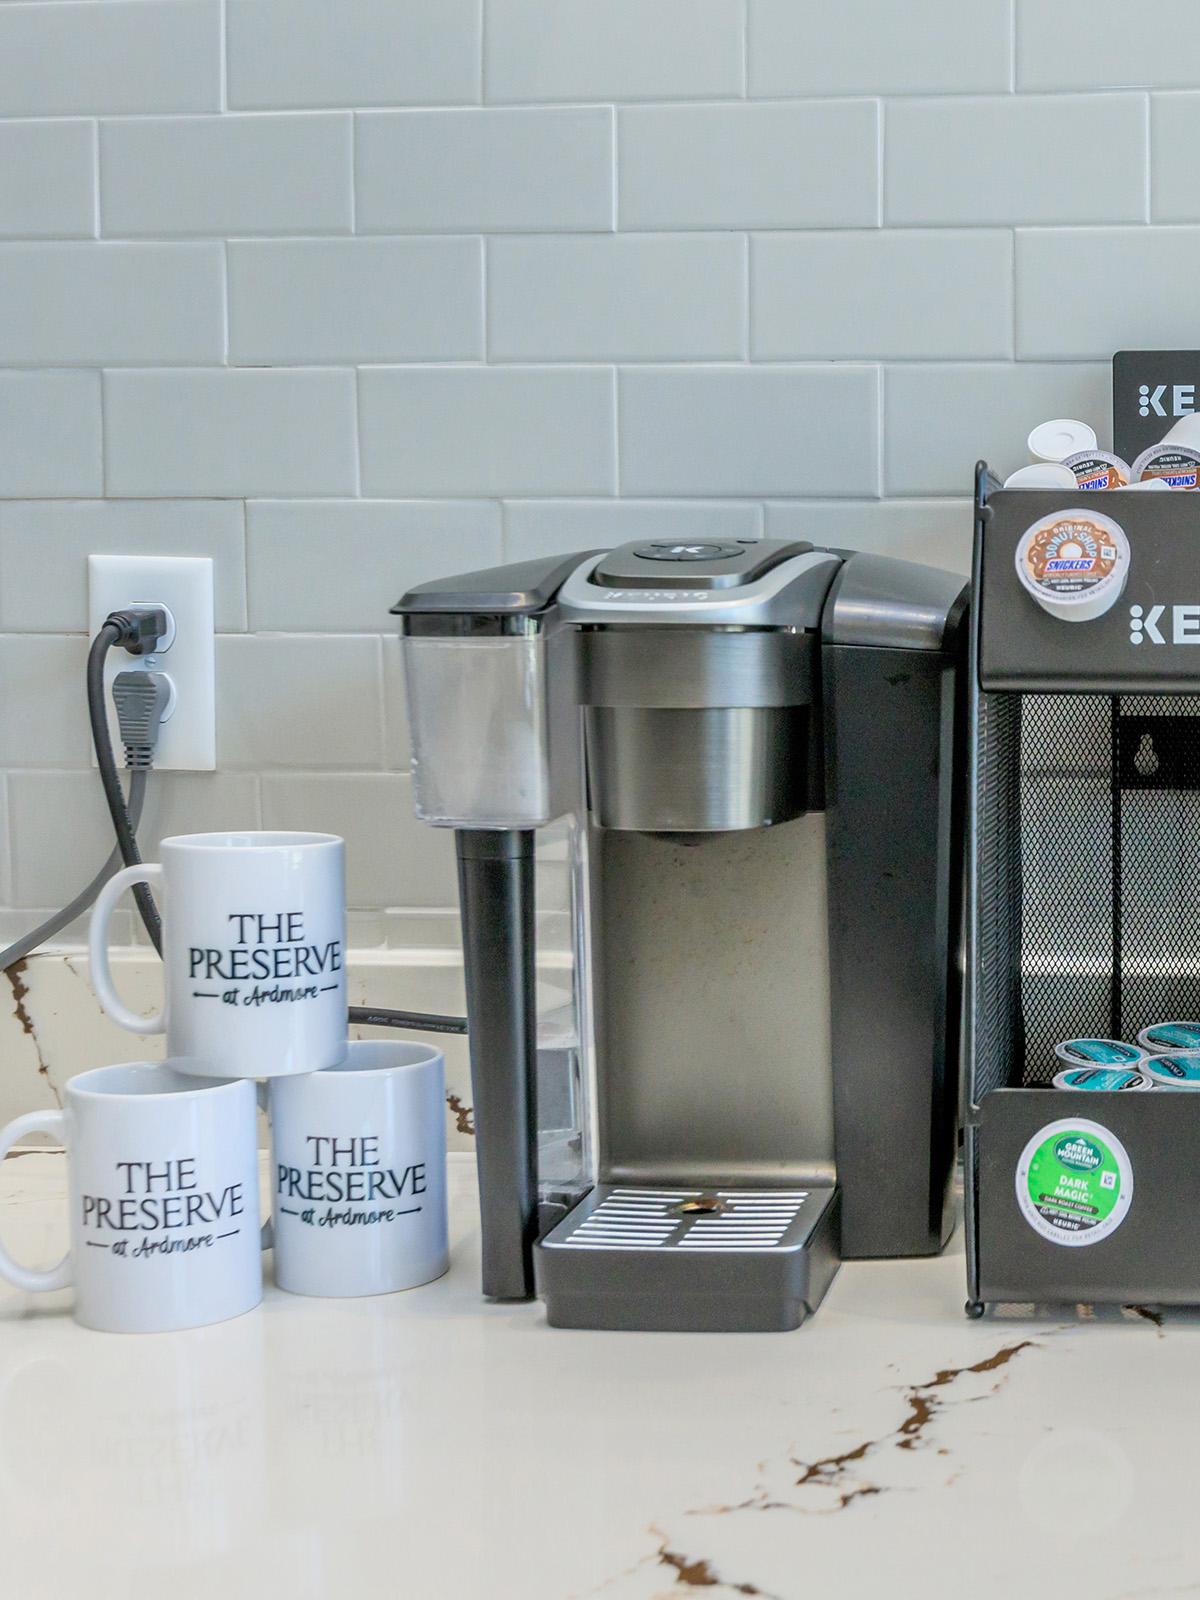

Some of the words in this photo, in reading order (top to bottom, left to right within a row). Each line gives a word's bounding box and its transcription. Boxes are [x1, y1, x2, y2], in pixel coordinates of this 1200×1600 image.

[1045, 531, 1074, 559] DONUT
[1077, 531, 1098, 558] SHOP
[1047, 559, 1093, 571] SNICKERS
[229, 911, 304, 944] THE
[188, 941, 342, 981] PRESERVE
[222, 988, 240, 1005] at
[244, 984, 320, 1007] Ardmore
[307, 1136, 380, 1167] THE
[1057, 1149, 1100, 1166] MOUNTAIN
[1065, 1142, 1094, 1157] GREEN
[117, 1158, 197, 1193] THE
[277, 1163, 427, 1203] PRESERVE
[1060, 1175, 1089, 1190] DARK
[82, 1183, 245, 1232] PRESERVE
[1054, 1186, 1089, 1204] MAGIC
[301, 1208, 317, 1227] at
[319, 1206, 396, 1228] Ardmore
[111, 1240, 129, 1258] at
[131, 1233, 215, 1258] Ardmore
